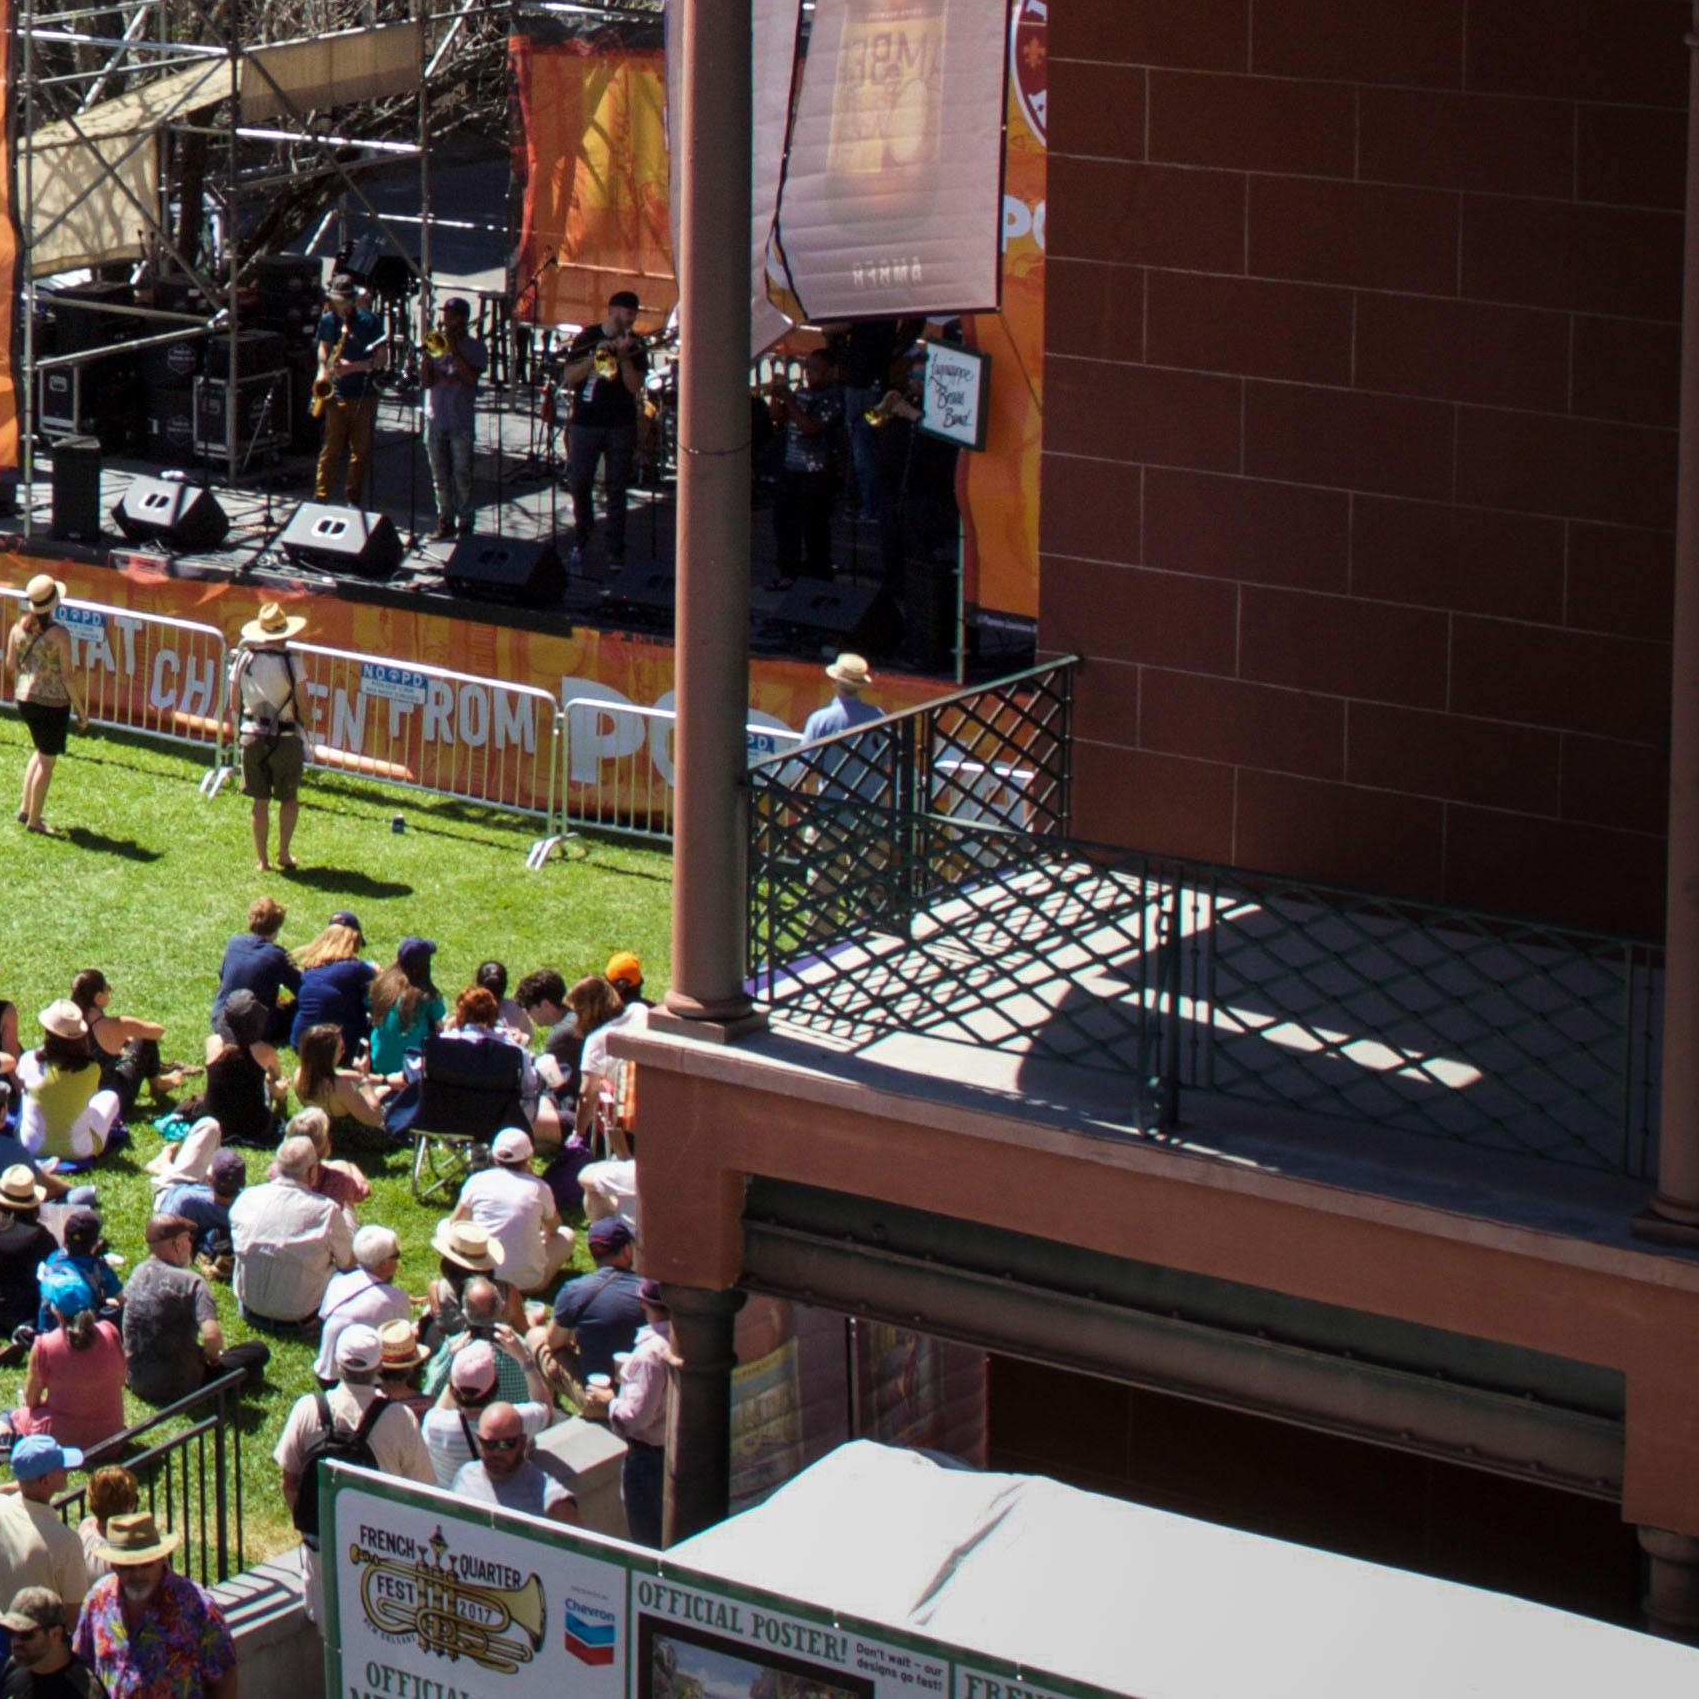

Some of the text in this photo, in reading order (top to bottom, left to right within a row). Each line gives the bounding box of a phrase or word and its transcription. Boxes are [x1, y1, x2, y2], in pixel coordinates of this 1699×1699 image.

[390, 678, 539, 755] FROM
[359, 1525, 415, 1557] FRENCH
[459, 1554, 521, 1589] QUARTER
[377, 1575, 416, 1605] FEST
[460, 1600, 494, 1624] 2017
[565, 1598, 616, 1622] Chevron
[638, 1580, 849, 1664] OFFICIAL POSTER!
[856, 1642, 945, 1679] Don't wait our
[856, 1659, 944, 1692] designs go fast!
